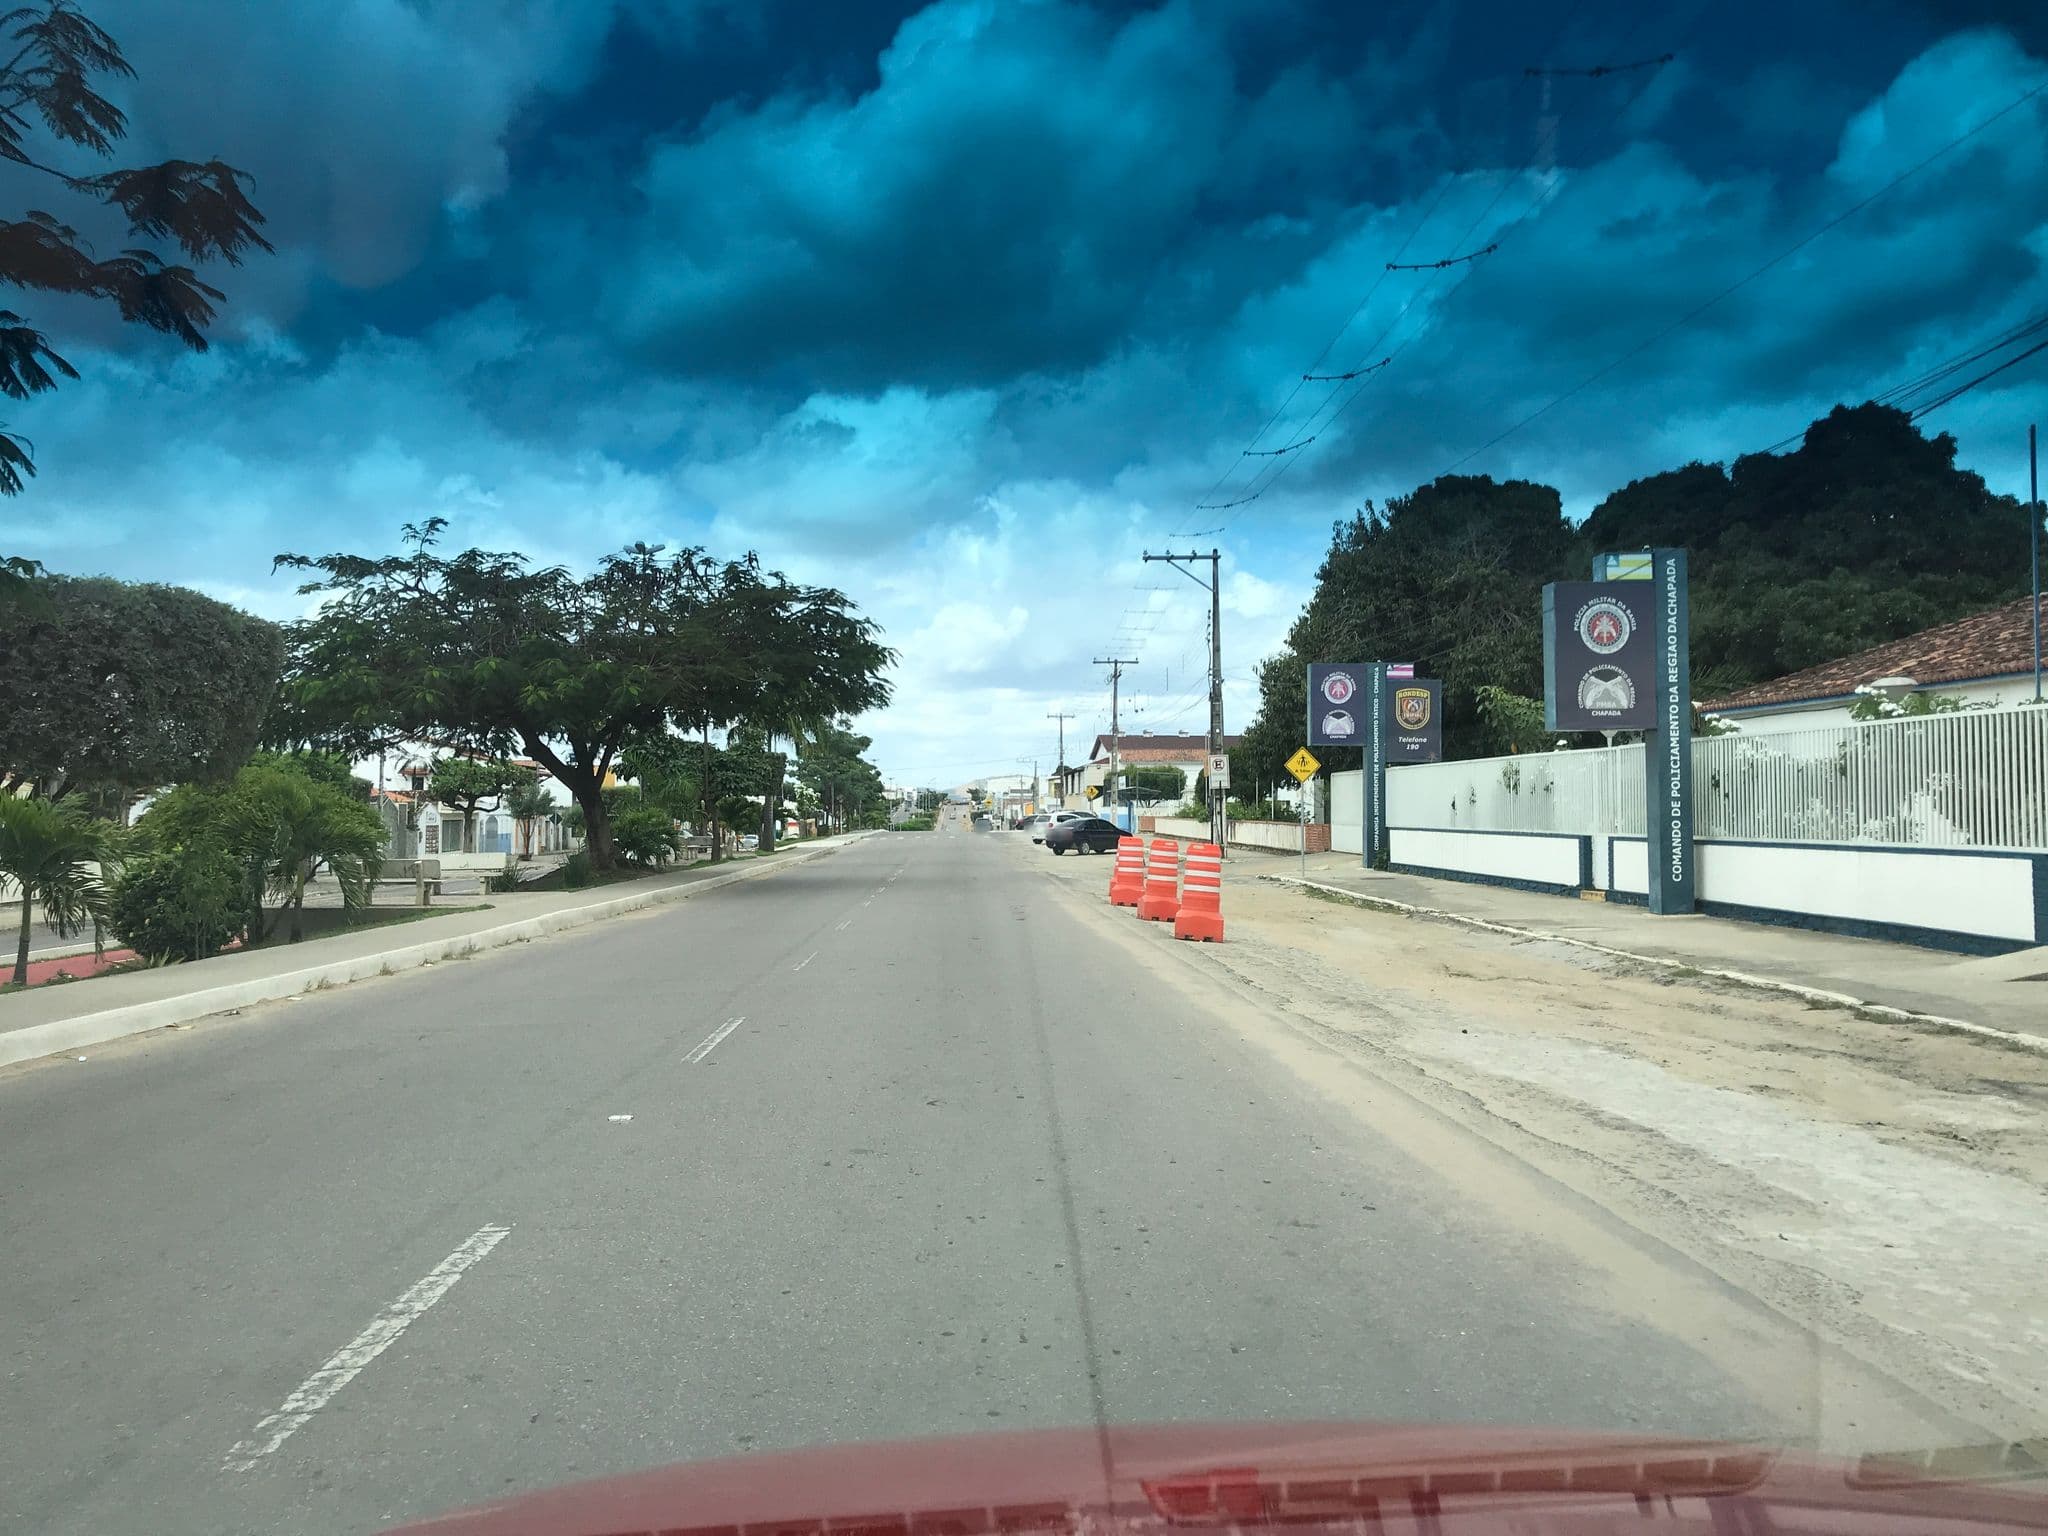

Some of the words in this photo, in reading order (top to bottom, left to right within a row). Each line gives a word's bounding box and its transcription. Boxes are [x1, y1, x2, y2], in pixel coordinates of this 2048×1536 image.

[1666, 558, 1677, 615] CHAPADA
[1588, 597, 1616, 606] MILITAR
[1617, 601, 1626, 610] DA
[1625, 609, 1637, 631] BAHIA
[1667, 617, 1677, 633] DA
[1669, 686, 1679, 702] DA
[1669, 705, 1680, 797] POLICIAMENTO
[1671, 801, 1681, 816] DE
[1671, 820, 1682, 881] COMANDO
